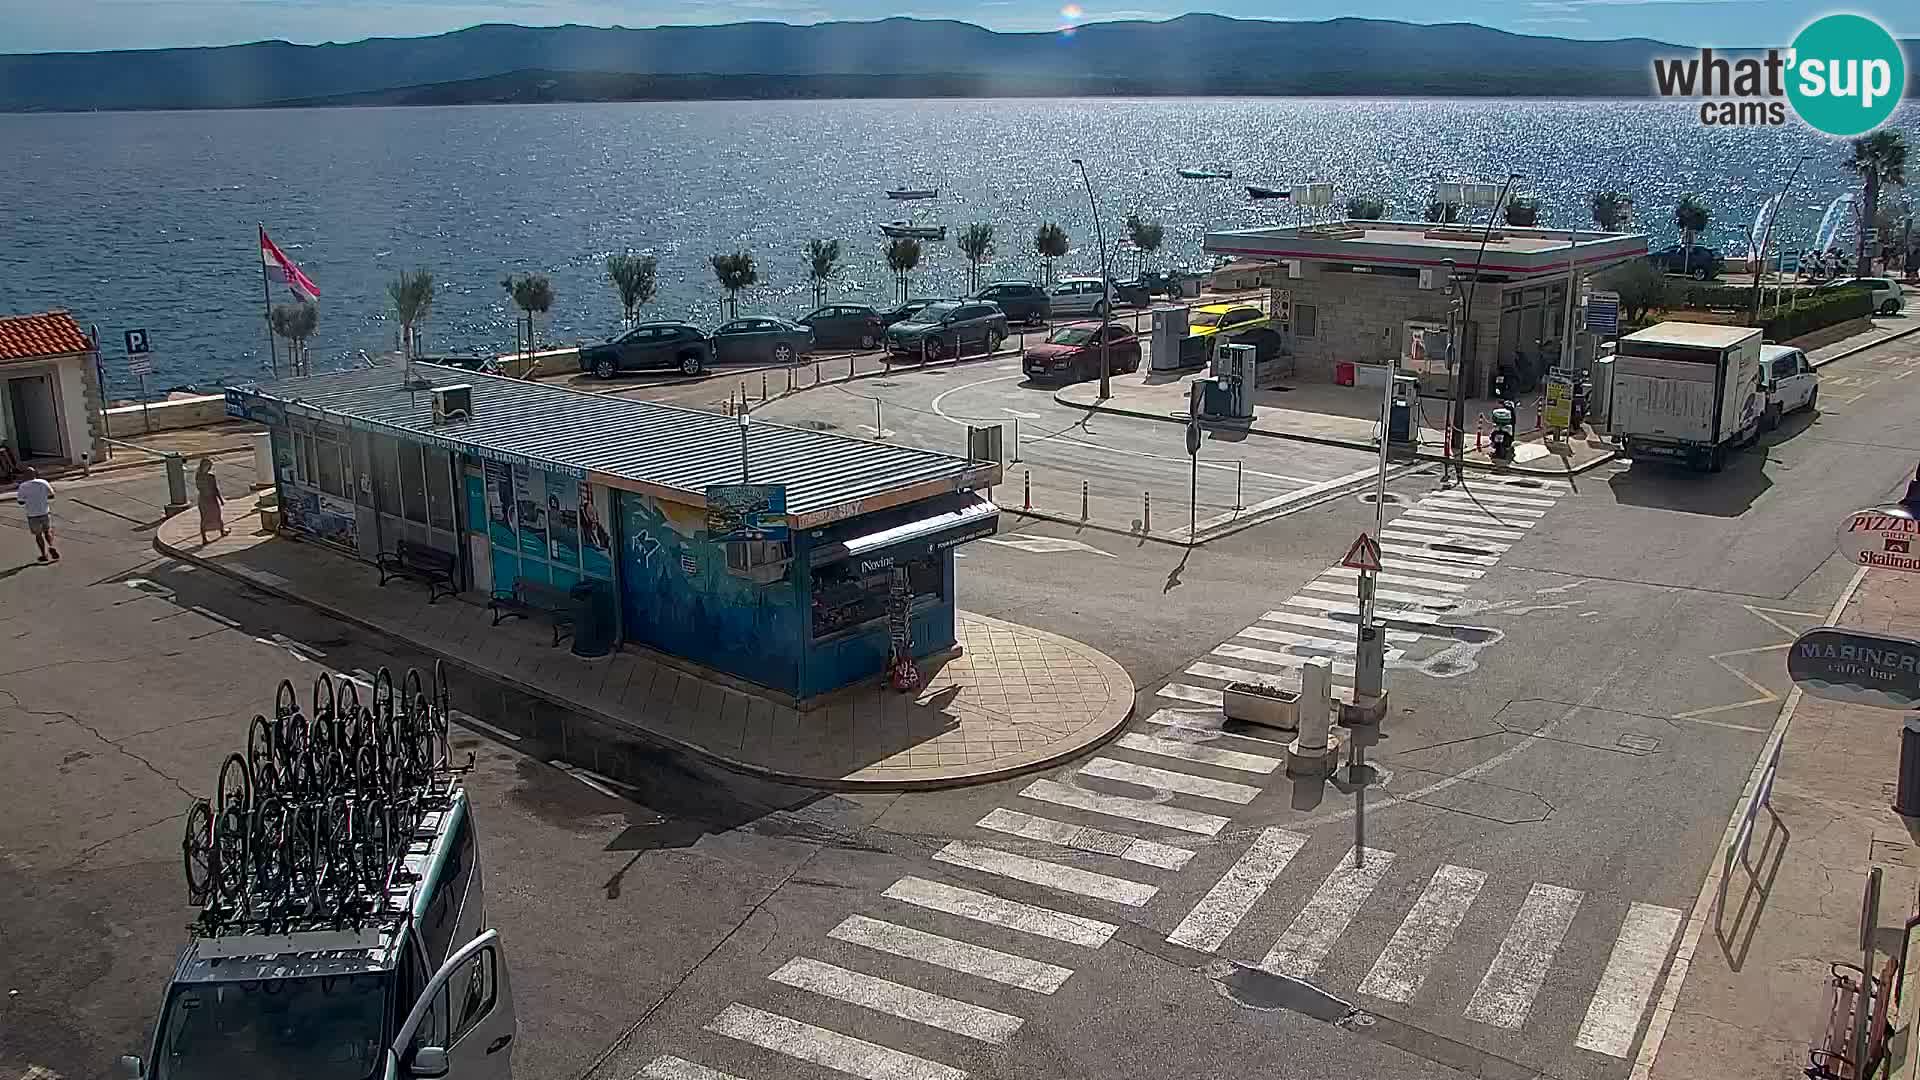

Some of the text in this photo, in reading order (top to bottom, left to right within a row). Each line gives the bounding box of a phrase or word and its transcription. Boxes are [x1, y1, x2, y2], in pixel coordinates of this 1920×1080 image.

[130, 333, 142, 351] P
[494, 451, 526, 465] STATION
[528, 459, 554, 472] TICKET
[556, 465, 583, 477] OFFICE
[1848, 515, 1920, 534] PIZZE
[1870, 667, 1896, 680] bar
